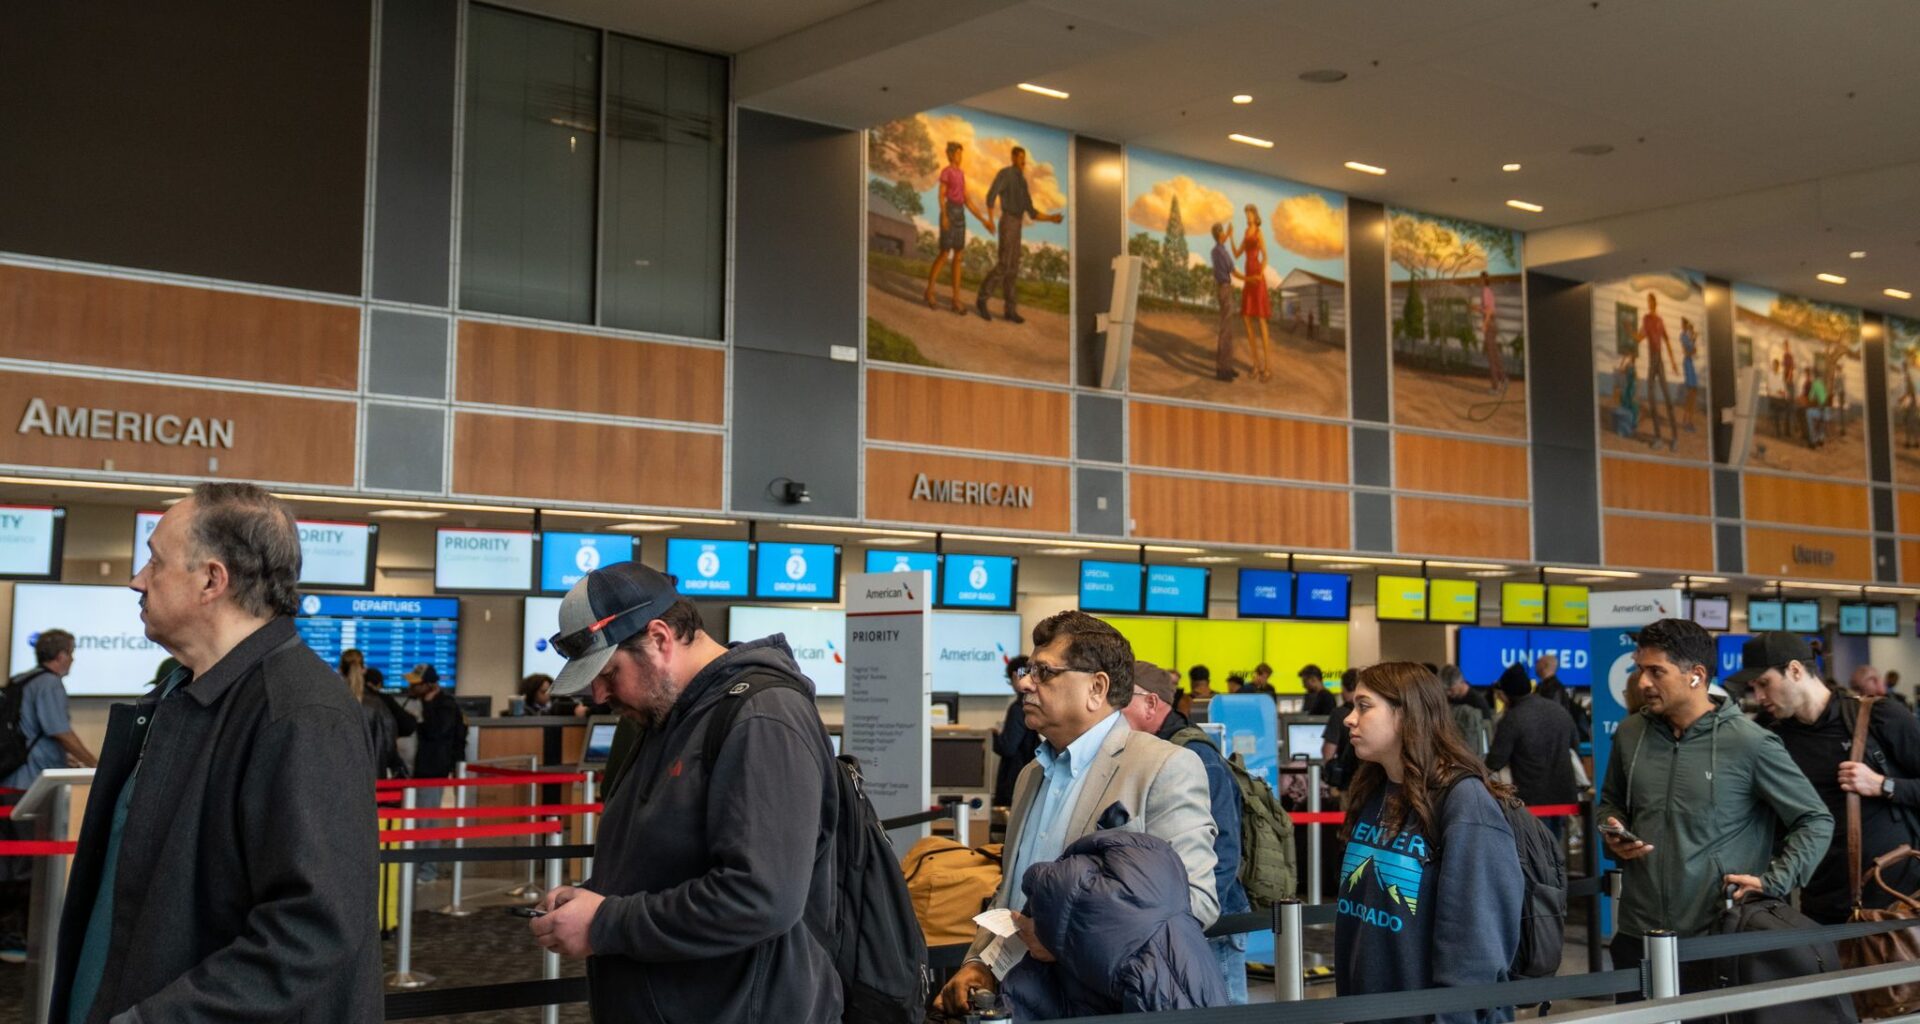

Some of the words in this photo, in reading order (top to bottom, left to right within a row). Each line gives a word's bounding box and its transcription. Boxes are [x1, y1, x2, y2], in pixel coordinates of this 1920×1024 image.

[18, 397, 236, 449] AMERICAN
[911, 472, 1034, 509] AMERICAN
[300, 528, 344, 543] ORITY
[444, 536, 511, 551] PRIORITY
[865, 588, 902, 600] American
[352, 599, 422, 614] DEPARTURES
[1611, 603, 1654, 614] American
[852, 630, 900, 643] PRIORITY
[793, 645, 825, 660] rican
[940, 647, 996, 662] American
[1603, 720, 1619, 734] TA
[1353, 822, 1426, 858] ENVER
[1338, 898, 1403, 933] OLORADO
